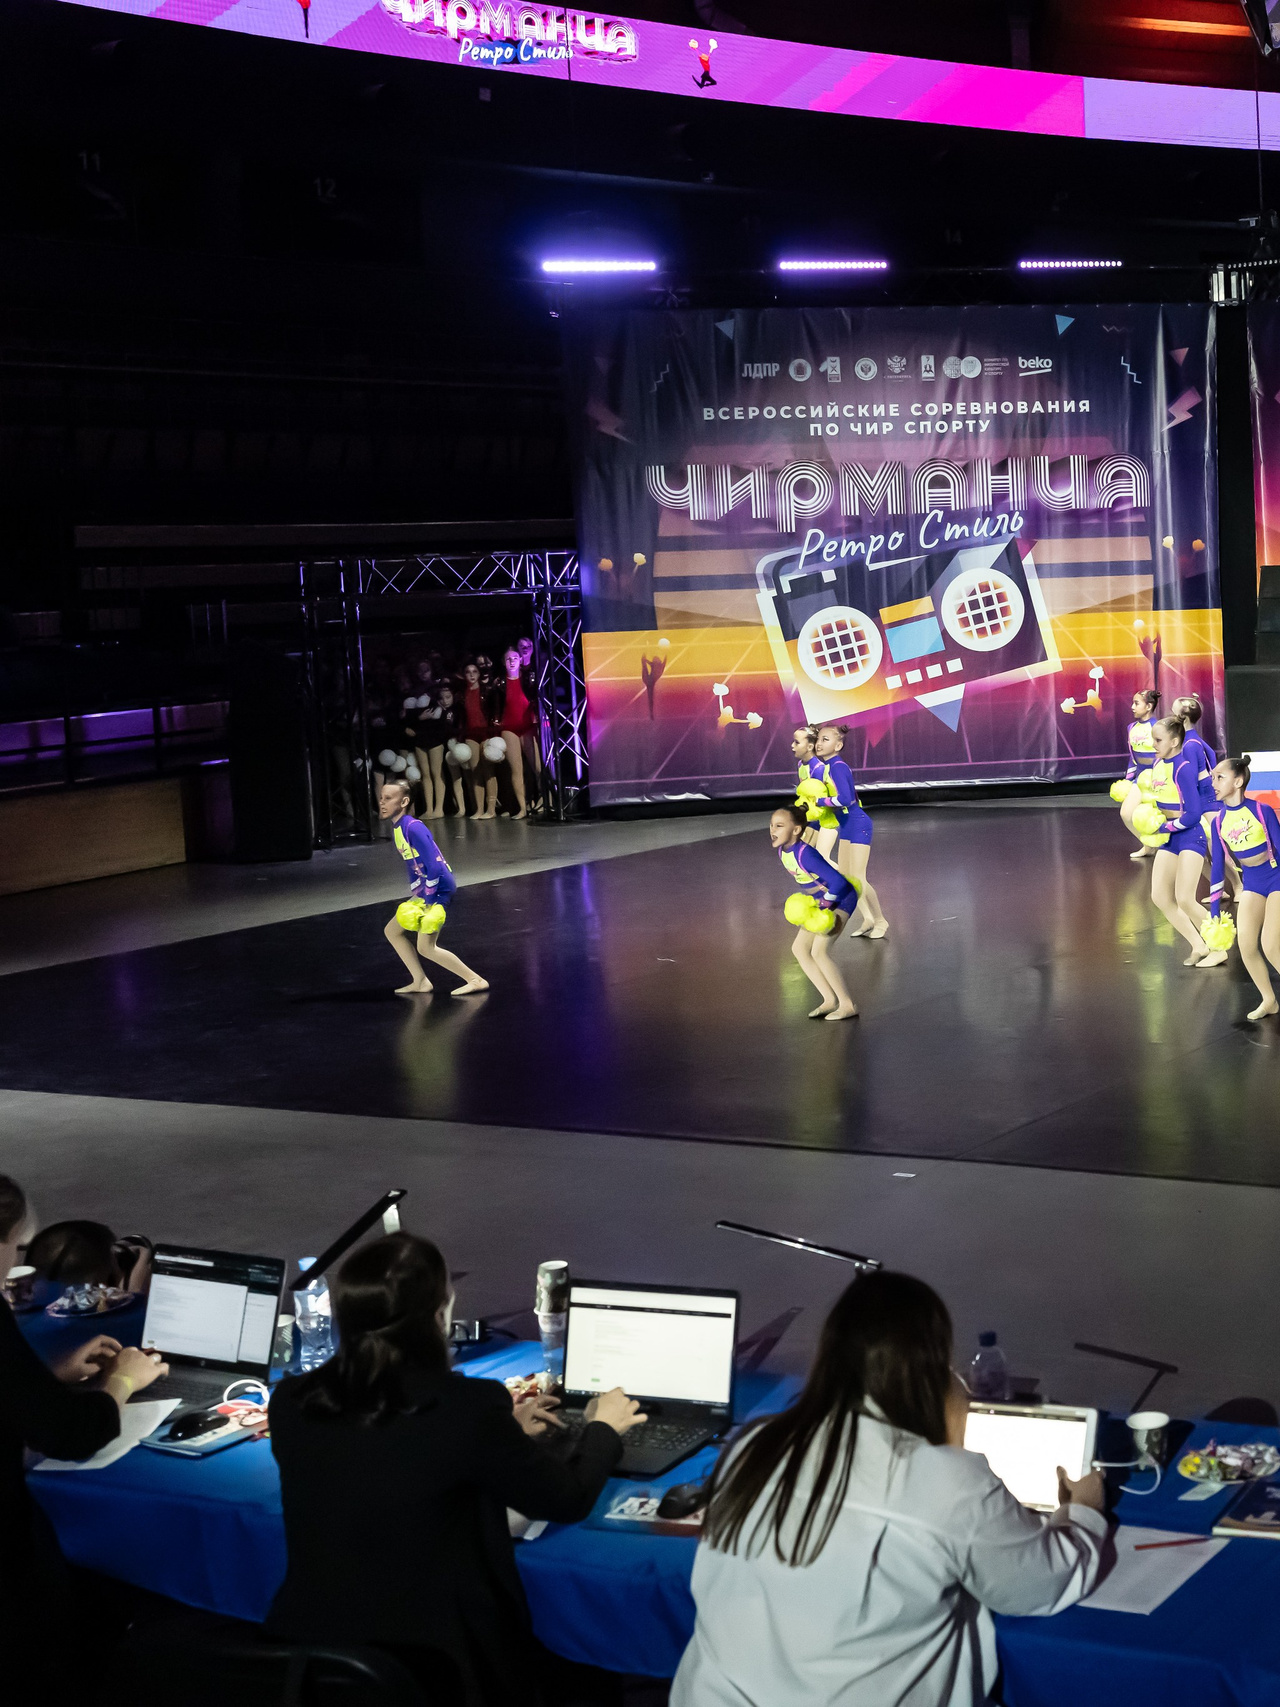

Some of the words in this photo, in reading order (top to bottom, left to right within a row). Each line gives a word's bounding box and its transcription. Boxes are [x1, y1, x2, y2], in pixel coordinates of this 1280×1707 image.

[458, 37, 514, 66] Ретро
[78, 150, 101, 172] 11
[313, 177, 337, 199] 12
[742, 362, 780, 379] ЛДПР
[1018, 356, 1053, 369] beko
[703, 402, 900, 421] ВСЕРОССИЙСКИЕ
[910, 400, 1091, 416] СОРЕВНОВАНИЯ
[809, 422, 840, 436] ПО
[849, 421, 894, 436] ЧИР
[904, 419, 991, 434] СПОРТУ
[799, 528, 905, 569] Ретро
[919, 509, 1024, 551] Стиль
